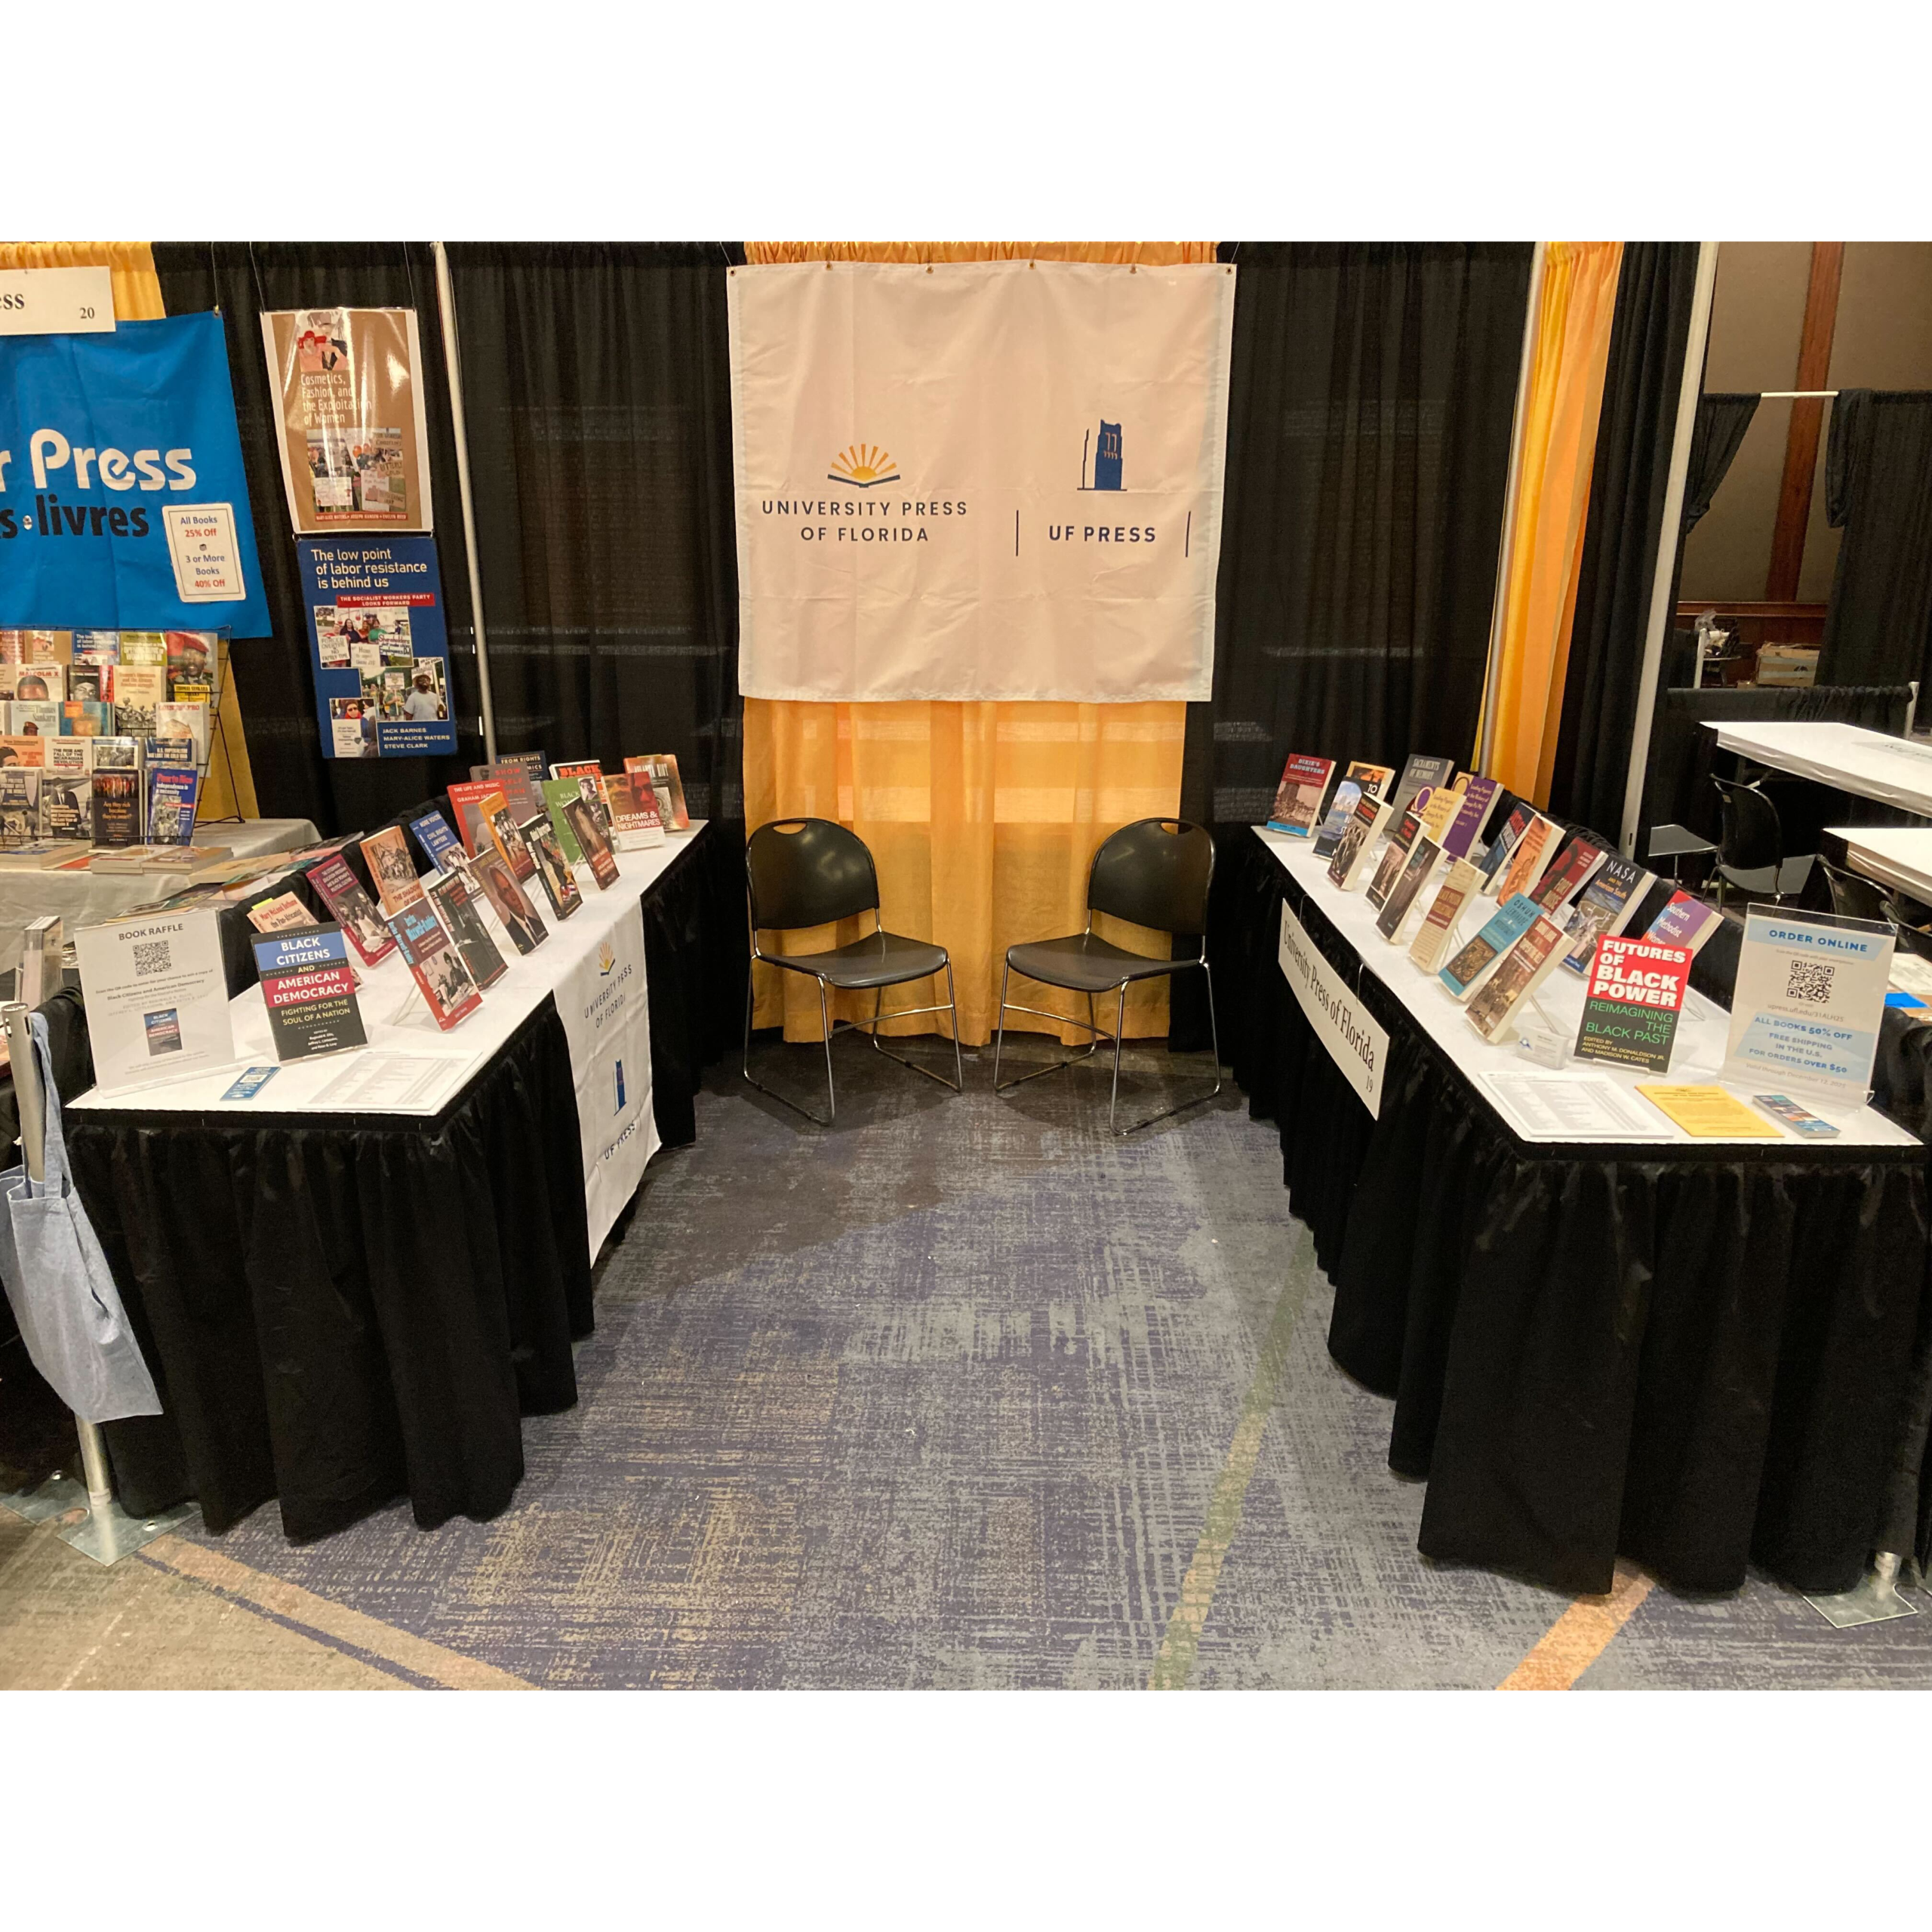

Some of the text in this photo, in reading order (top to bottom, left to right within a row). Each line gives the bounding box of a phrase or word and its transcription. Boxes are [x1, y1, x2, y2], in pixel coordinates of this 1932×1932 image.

[79, 307, 95, 319] 20
[301, 374, 346, 385] Cosmetics,
[303, 401, 316, 412] the
[303, 414, 312, 426] of
[30, 429, 196, 491] Press
[35, 494, 149, 537] livres
[762, 500, 968, 517] UNIVERSITY PRESS
[180, 516, 217, 525] All Books
[185, 528, 217, 538] 25% Off
[801, 528, 929, 543] OF FLORIDA
[1049, 526, 1157, 543] UF PRESS
[203, 554, 225, 563] More
[311, 548, 392, 563] The low point
[195, 567, 220, 575] Books
[316, 561, 427, 575] of labor resistance
[195, 579, 225, 588] 40% Off
[318, 576, 389, 589] is behind us
[559, 764, 601, 775] BLACK
[1289, 763, 1325, 775] DAUGHTERS
[1298, 758, 1320, 768] DIXIE'S
[1413, 758, 1441, 771] SACRAMENTS
[560, 791, 580, 799] BLACK
[1367, 784, 1378, 794] TO
[457, 795, 480, 803] GRAHAM
[616, 812, 648, 823] DREAMS
[617, 819, 661, 830] NIGHTMARES
[426, 832, 437, 840] CIVIL
[431, 835, 448, 848] LAWYERS
[1606, 860, 1636, 884] NASA
[393, 884, 421, 903] THE SHADOW
[1595, 878, 1627, 899] American South
[260, 899, 298, 921] Mary McLeod Bethune
[1513, 899, 1535, 918] OSHUN
[1666, 902, 1690, 921] Southern
[270, 919, 279, 929] the
[1657, 916, 1682, 938] Methodist
[118, 923, 184, 941] BOOK RAFFLE
[281, 937, 321, 952] BLACK
[1769, 929, 1868, 952] ORDER ONLINE
[276, 949, 331, 965] CITIZENS
[1599, 952, 1625, 966] OF
[1602, 940, 1686, 964] FUTURES
[297, 965, 315, 974] AND
[153, 983, 177, 992] American
[177, 979, 205, 988] Democracy
[278, 971, 340, 990] AMERICAN
[1596, 964, 1680, 992] BLACK
[273, 983, 349, 1004] DEMOCRACY
[1284, 920, 1374, 1072] University Press of Florida
[1592, 980, 1678, 1008] POWER
[281, 1004, 317, 1017] FIGHTING
[318, 1001, 333, 1010] FOR
[1589, 1001, 1674, 1023] REIMAGINING
[282, 1017, 303, 1026] SOUL
[322, 1008, 351, 1018] NATION
[595, 1017, 605, 1029] OF
[1586, 1022, 1670, 1045] BLACK PAST
[1646, 1021, 1672, 1035] THE
[1755, 1017, 1853, 1041] ALL BOOKS 50% OFF
[1583, 1035, 1604, 1044] EDITED
[1769, 1032, 1832, 1051] FREE SHIPPING
[1582, 1041, 1611, 1051] ANTHONY
[1619, 1048, 1657, 1059] DONALDSON
[1595, 1050, 1623, 1058] MADISON
[1787, 1045, 1804, 1054] THE
[1806, 1050, 1823, 1058] U.S.
[1749, 1048, 1847, 1074] FOR ORDERS OVER $50
[1746, 1063, 1761, 1072] Valid
[1762, 1066, 1787, 1077] through
[1787, 1072, 1820, 1083] December
[1365, 1075, 1374, 1094] 19
[605, 1143, 614, 1160] UF
